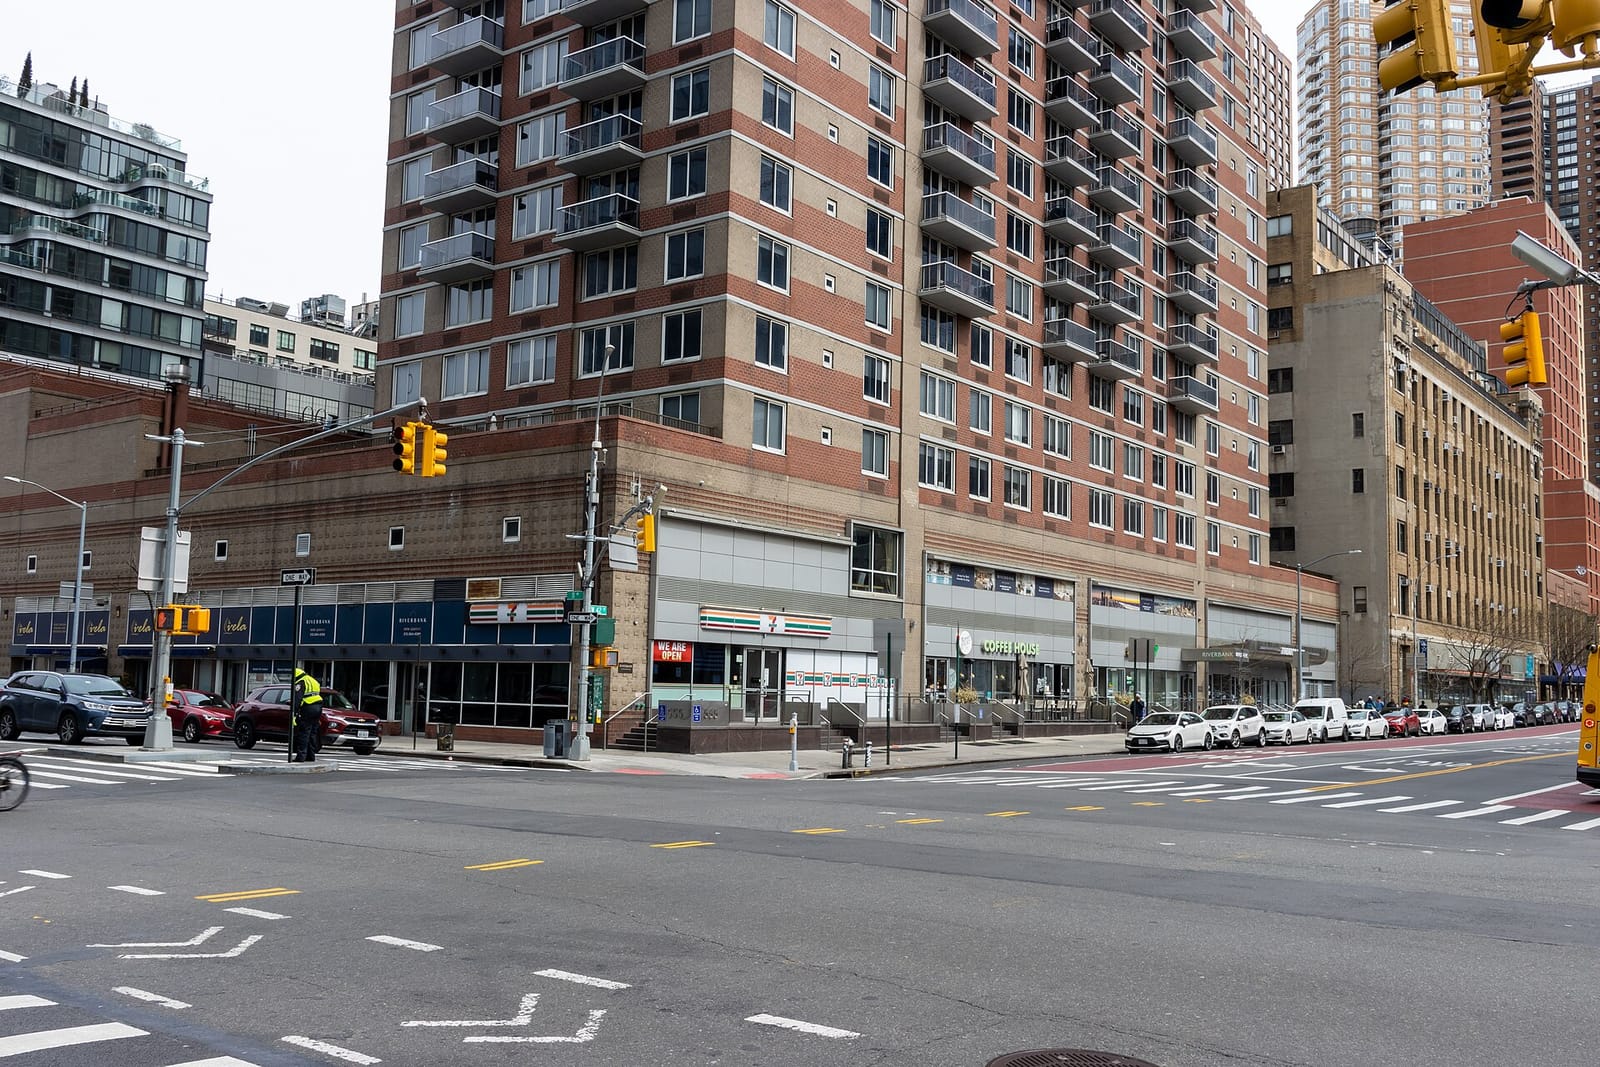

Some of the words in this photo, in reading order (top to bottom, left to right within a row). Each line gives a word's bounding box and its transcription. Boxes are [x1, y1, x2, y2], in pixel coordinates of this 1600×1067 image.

[658, 642, 670, 650] WE
[672, 642, 687, 651] ARE
[983, 639, 1012, 654] COFFEE
[1014, 643, 1040, 655] HOUSE
[661, 650, 682, 660] OPEN
